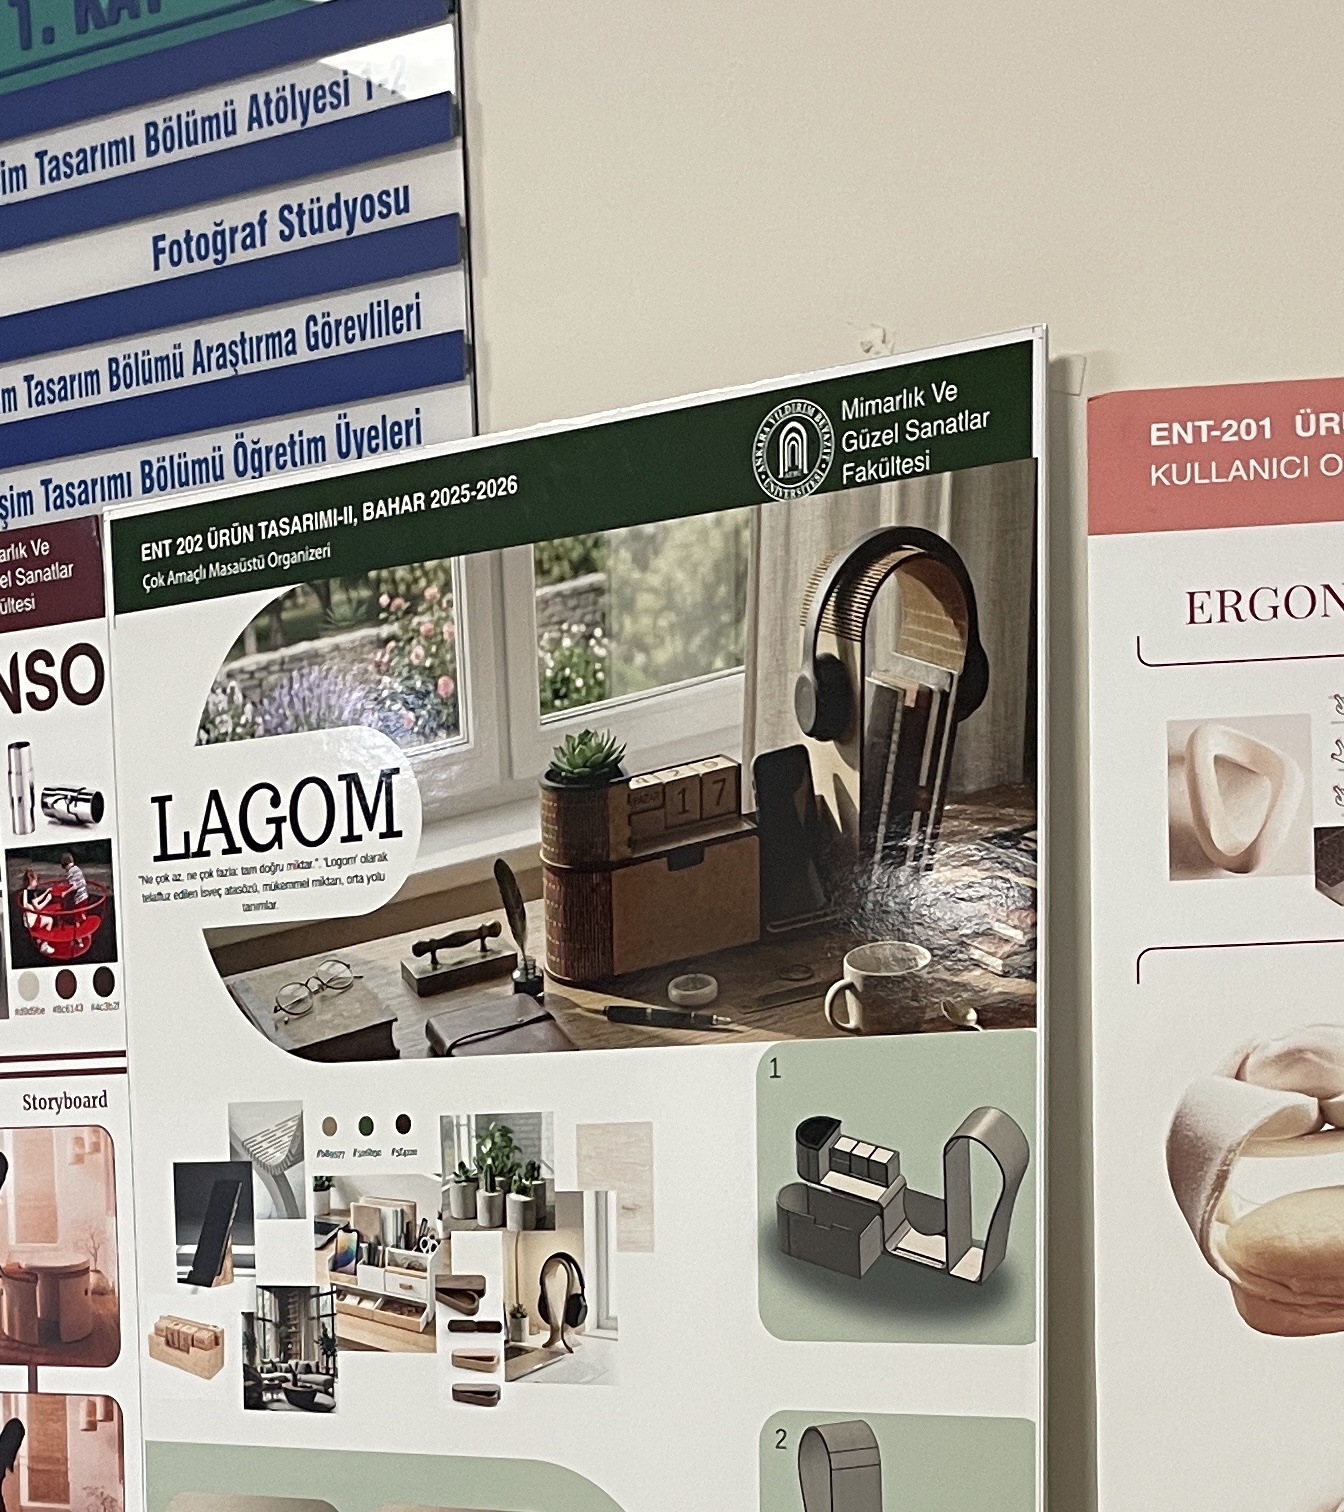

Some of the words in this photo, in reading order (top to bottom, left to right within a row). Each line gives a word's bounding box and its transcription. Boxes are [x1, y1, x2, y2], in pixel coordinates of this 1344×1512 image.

[34, 134, 136, 186] Tasarımı
[144, 99, 238, 158] Bölümü
[247, 69, 351, 132] Atölyesi
[152, 210, 267, 272] Fotoğraf
[278, 184, 411, 242] Stüdyosu
[23, 368, 101, 409] Tasarım
[107, 342, 185, 393] Bölümü
[192, 328, 298, 376] Araştırma
[306, 291, 422, 352] Görevlileri
[841, 386, 926, 421] Mimarlık
[931, 380, 958, 402] Ve
[841, 422, 899, 453] Güzel
[905, 410, 991, 442] Sanatlar
[1149, 417, 1273, 446] ENT-201
[40, 471, 133, 513] Tasarımı
[140, 446, 225, 495] Bölümü
[233, 429, 328, 480] Öğretim
[335, 407, 423, 460] Üyeleri
[842, 449, 931, 485] Fakültesi
[1149, 454, 1309, 487] KULLANICI
[141, 539, 173, 562] ENT
[176, 534, 204, 556] 202
[207, 522, 254, 550] ÜRÜN
[258, 505, 358, 540] TASARIMI-II,
[362, 492, 426, 522] BAHAR
[430, 475, 519, 509] 2025-2026
[30, 539, 50, 557] Ve
[15, 561, 74, 588] Sanatlar
[142, 571, 166, 594] Çok
[166, 565, 206, 586] Amaçlı
[208, 555, 266, 578] Masaüstü
[267, 542, 331, 570] Organizeri
[150, 767, 403, 862] LAGOM
[677, 787, 690, 815] 1
[712, 777, 727, 806] 7
[769, 1057, 782, 1079] 1
[22, 1089, 108, 1116] Storyboard
[775, 1429, 788, 1450] 2
